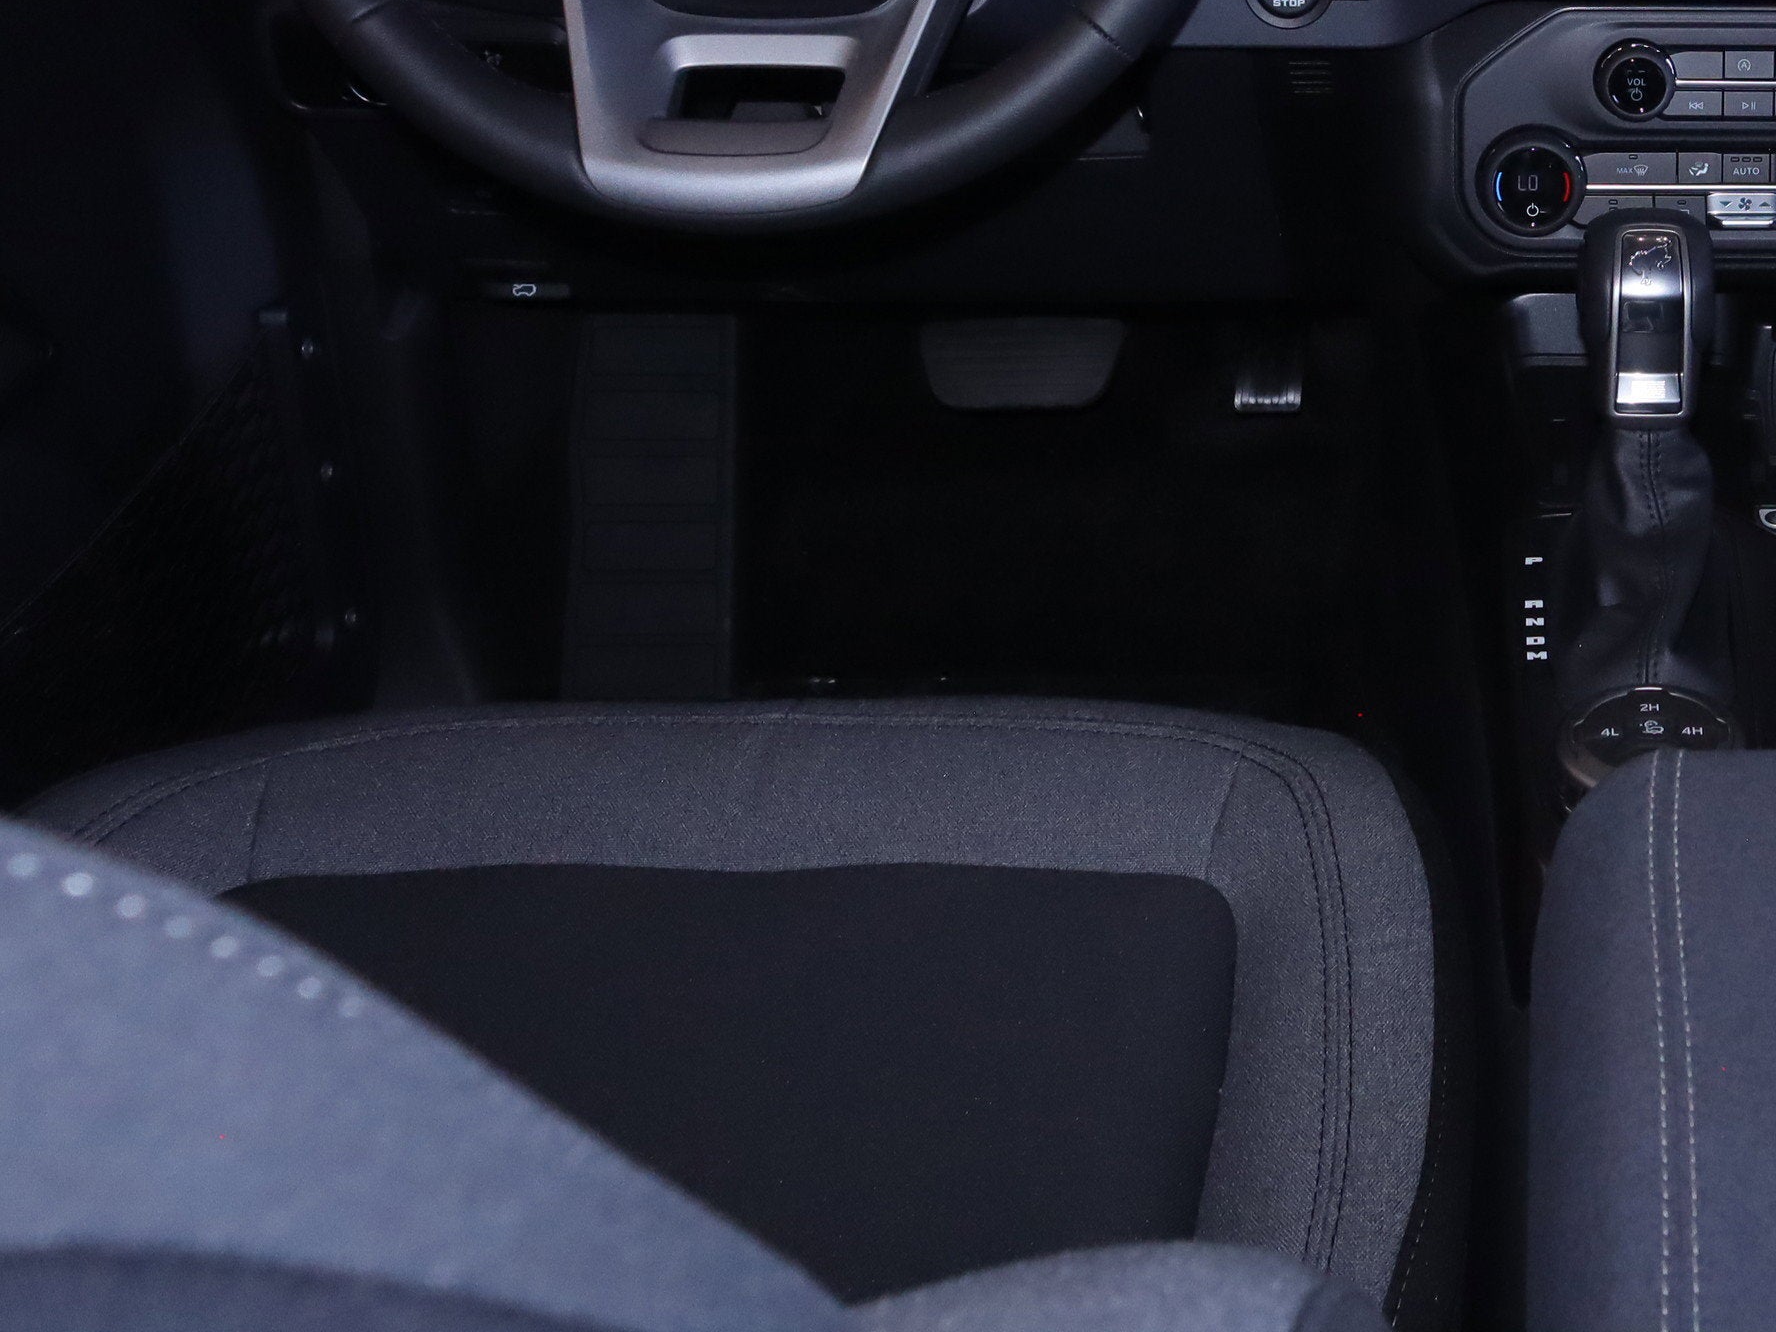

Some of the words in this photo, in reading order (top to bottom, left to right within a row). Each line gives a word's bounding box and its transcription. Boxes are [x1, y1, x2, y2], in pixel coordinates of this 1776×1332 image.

[1273, 0, 1306, 7] STOP
[1627, 77, 1646, 86] VOL
[1733, 166, 1760, 176] AUTO
[1517, 174, 1538, 191] LO
[1525, 557, 1543, 565] P
[1525, 618, 1544, 626] N
[1526, 636, 1545, 645] D
[1526, 651, 1548, 660] M
[1640, 703, 1659, 712] 2H
[1601, 728, 1619, 737] 4L
[1681, 727, 1703, 735] 4H
